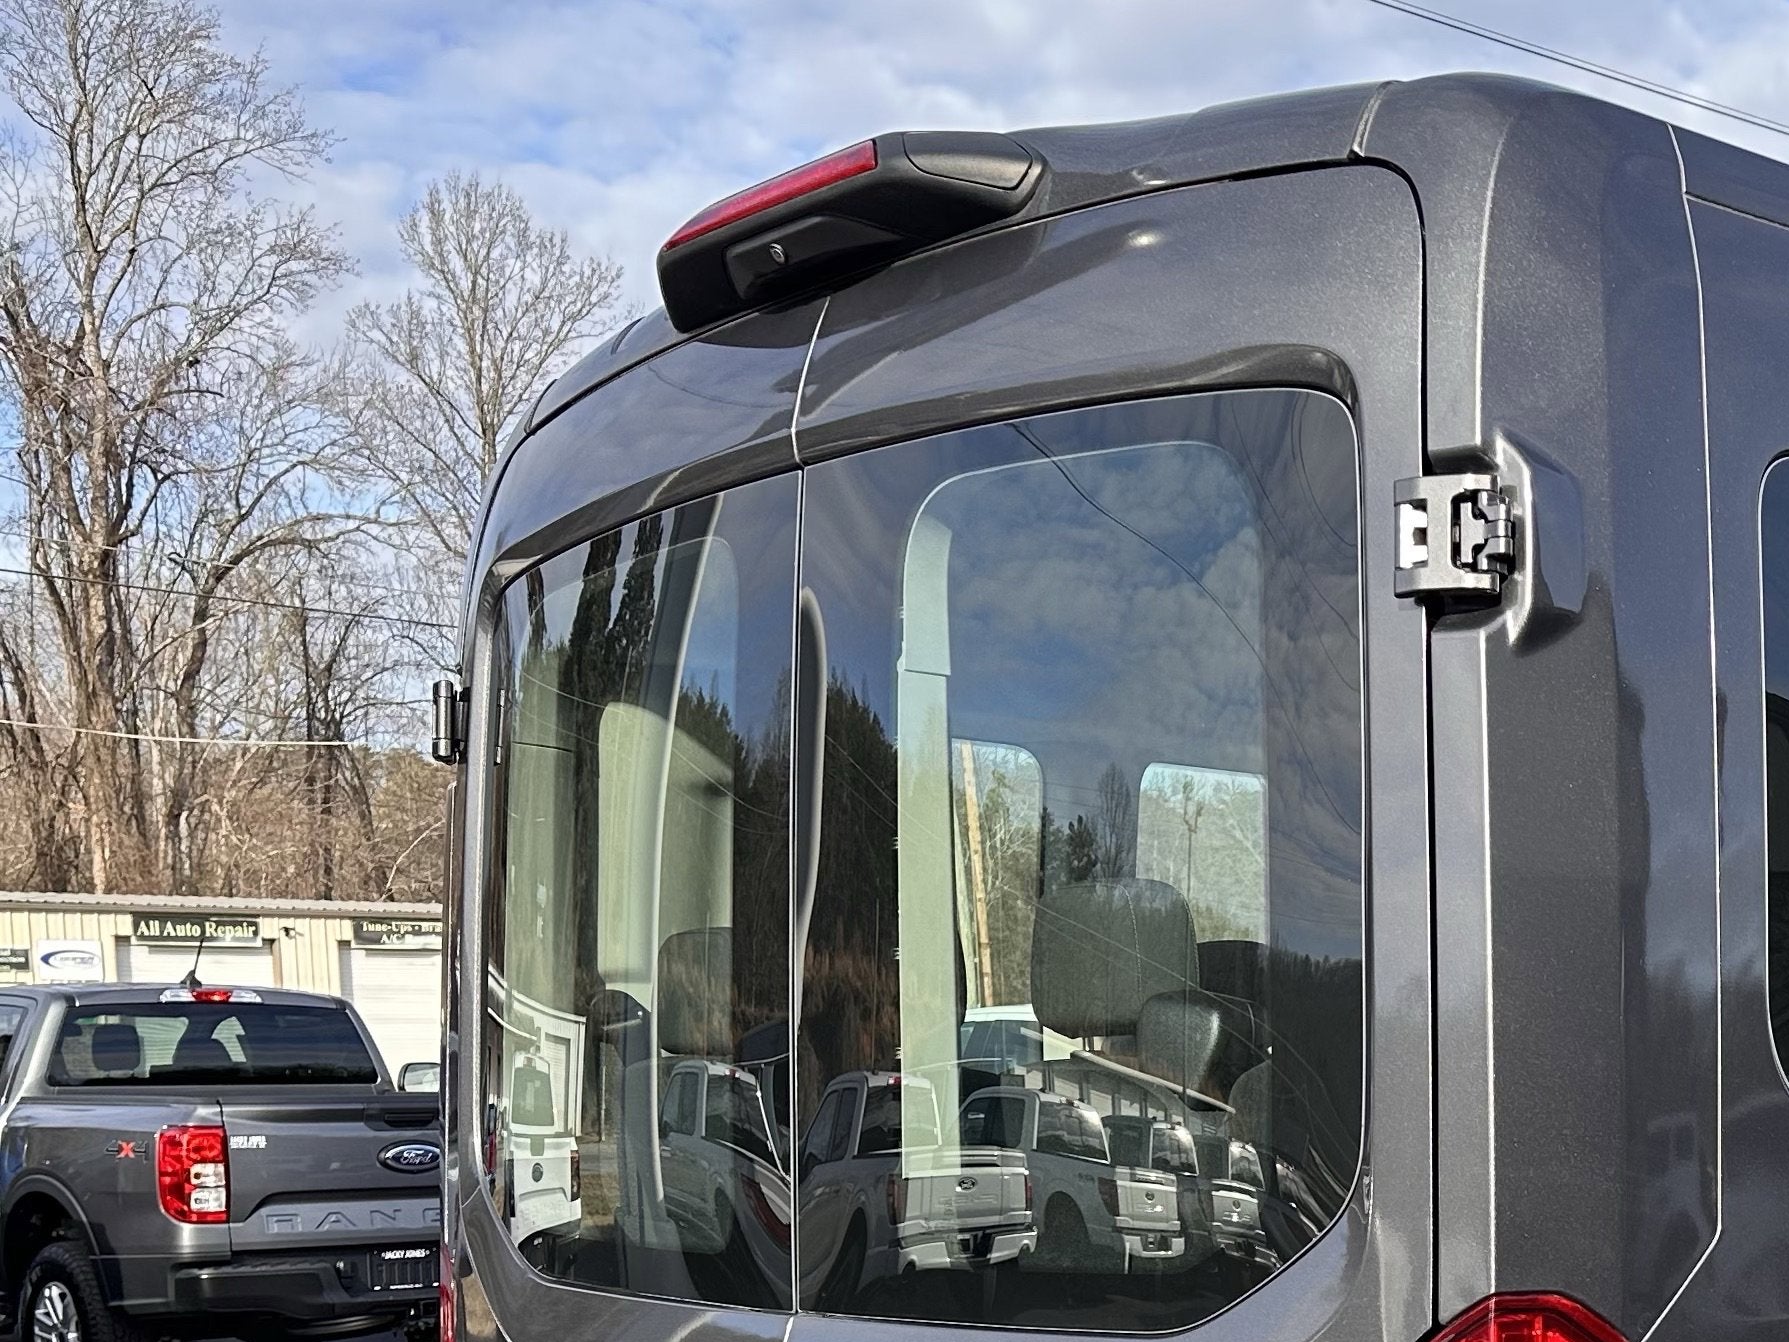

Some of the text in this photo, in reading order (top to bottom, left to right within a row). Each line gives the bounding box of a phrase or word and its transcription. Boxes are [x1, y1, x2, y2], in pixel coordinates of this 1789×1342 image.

[137, 920, 256, 941] All Auto Repair
[400, 1150, 433, 1165] Ford
